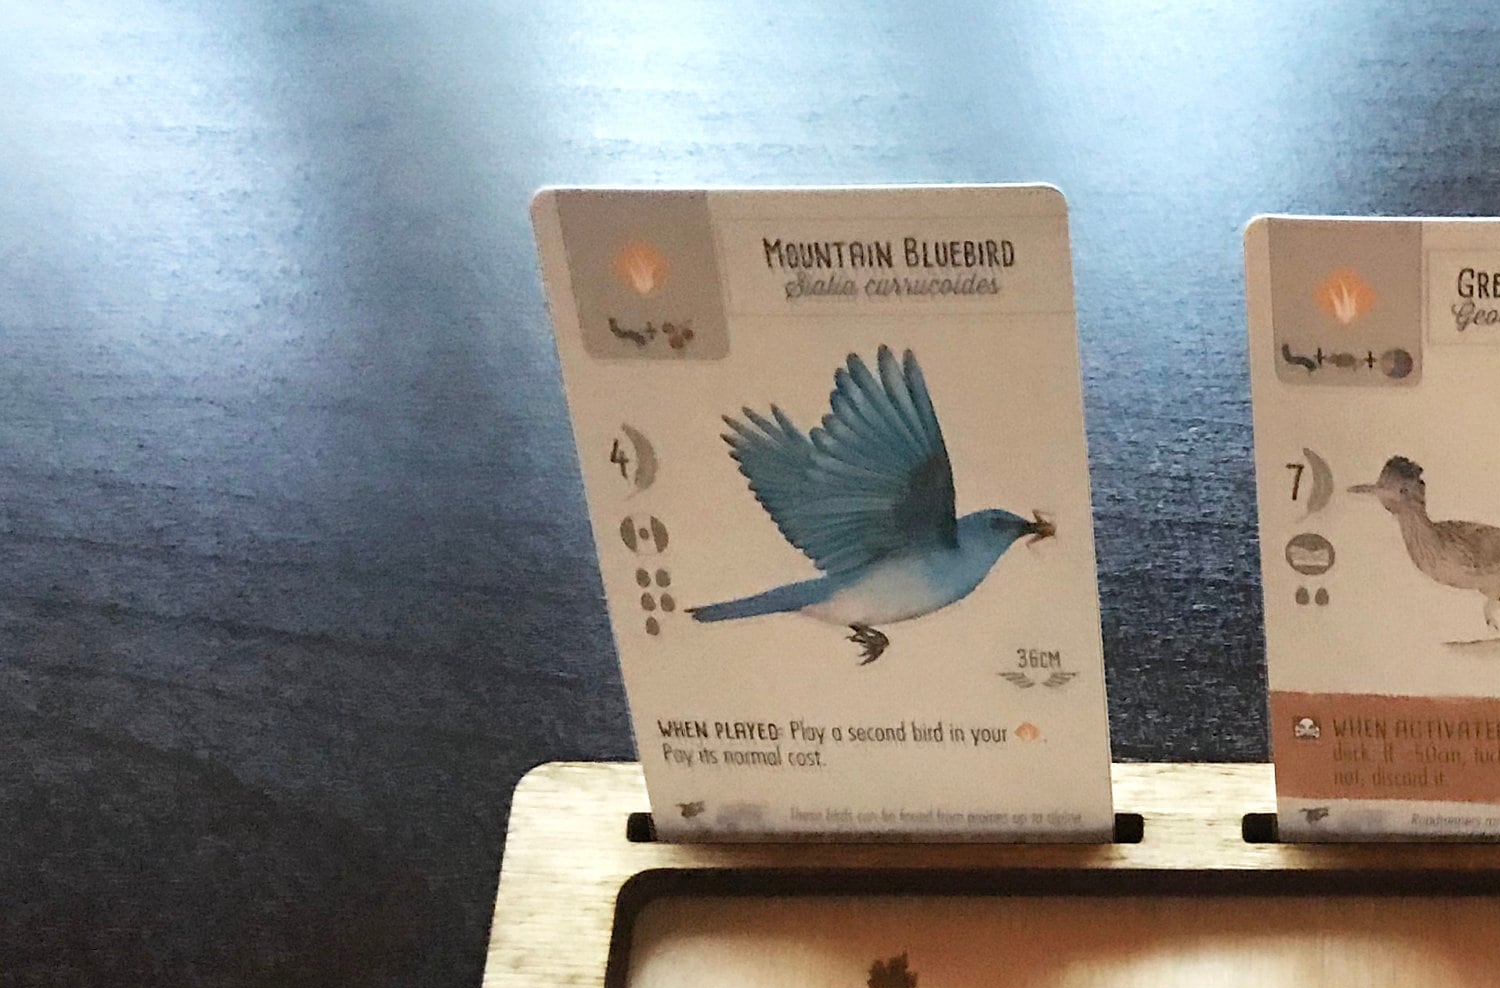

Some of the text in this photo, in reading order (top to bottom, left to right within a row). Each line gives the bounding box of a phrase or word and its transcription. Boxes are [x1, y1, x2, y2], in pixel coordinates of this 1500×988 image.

[610, 439, 629, 480] 4
[1286, 463, 1305, 501] 7
[658, 720, 708, 739] WHEN
[790, 721, 826, 744] Play
[832, 728, 842, 741] a
[850, 722, 906, 743] second
[911, 722, 943, 743] bird
[950, 723, 965, 742] in
[971, 728, 1007, 746] your
[1333, 718, 1386, 739] WHEN
[663, 743, 692, 768] Pay
[701, 747, 718, 765] its
[724, 746, 782, 767] normal
